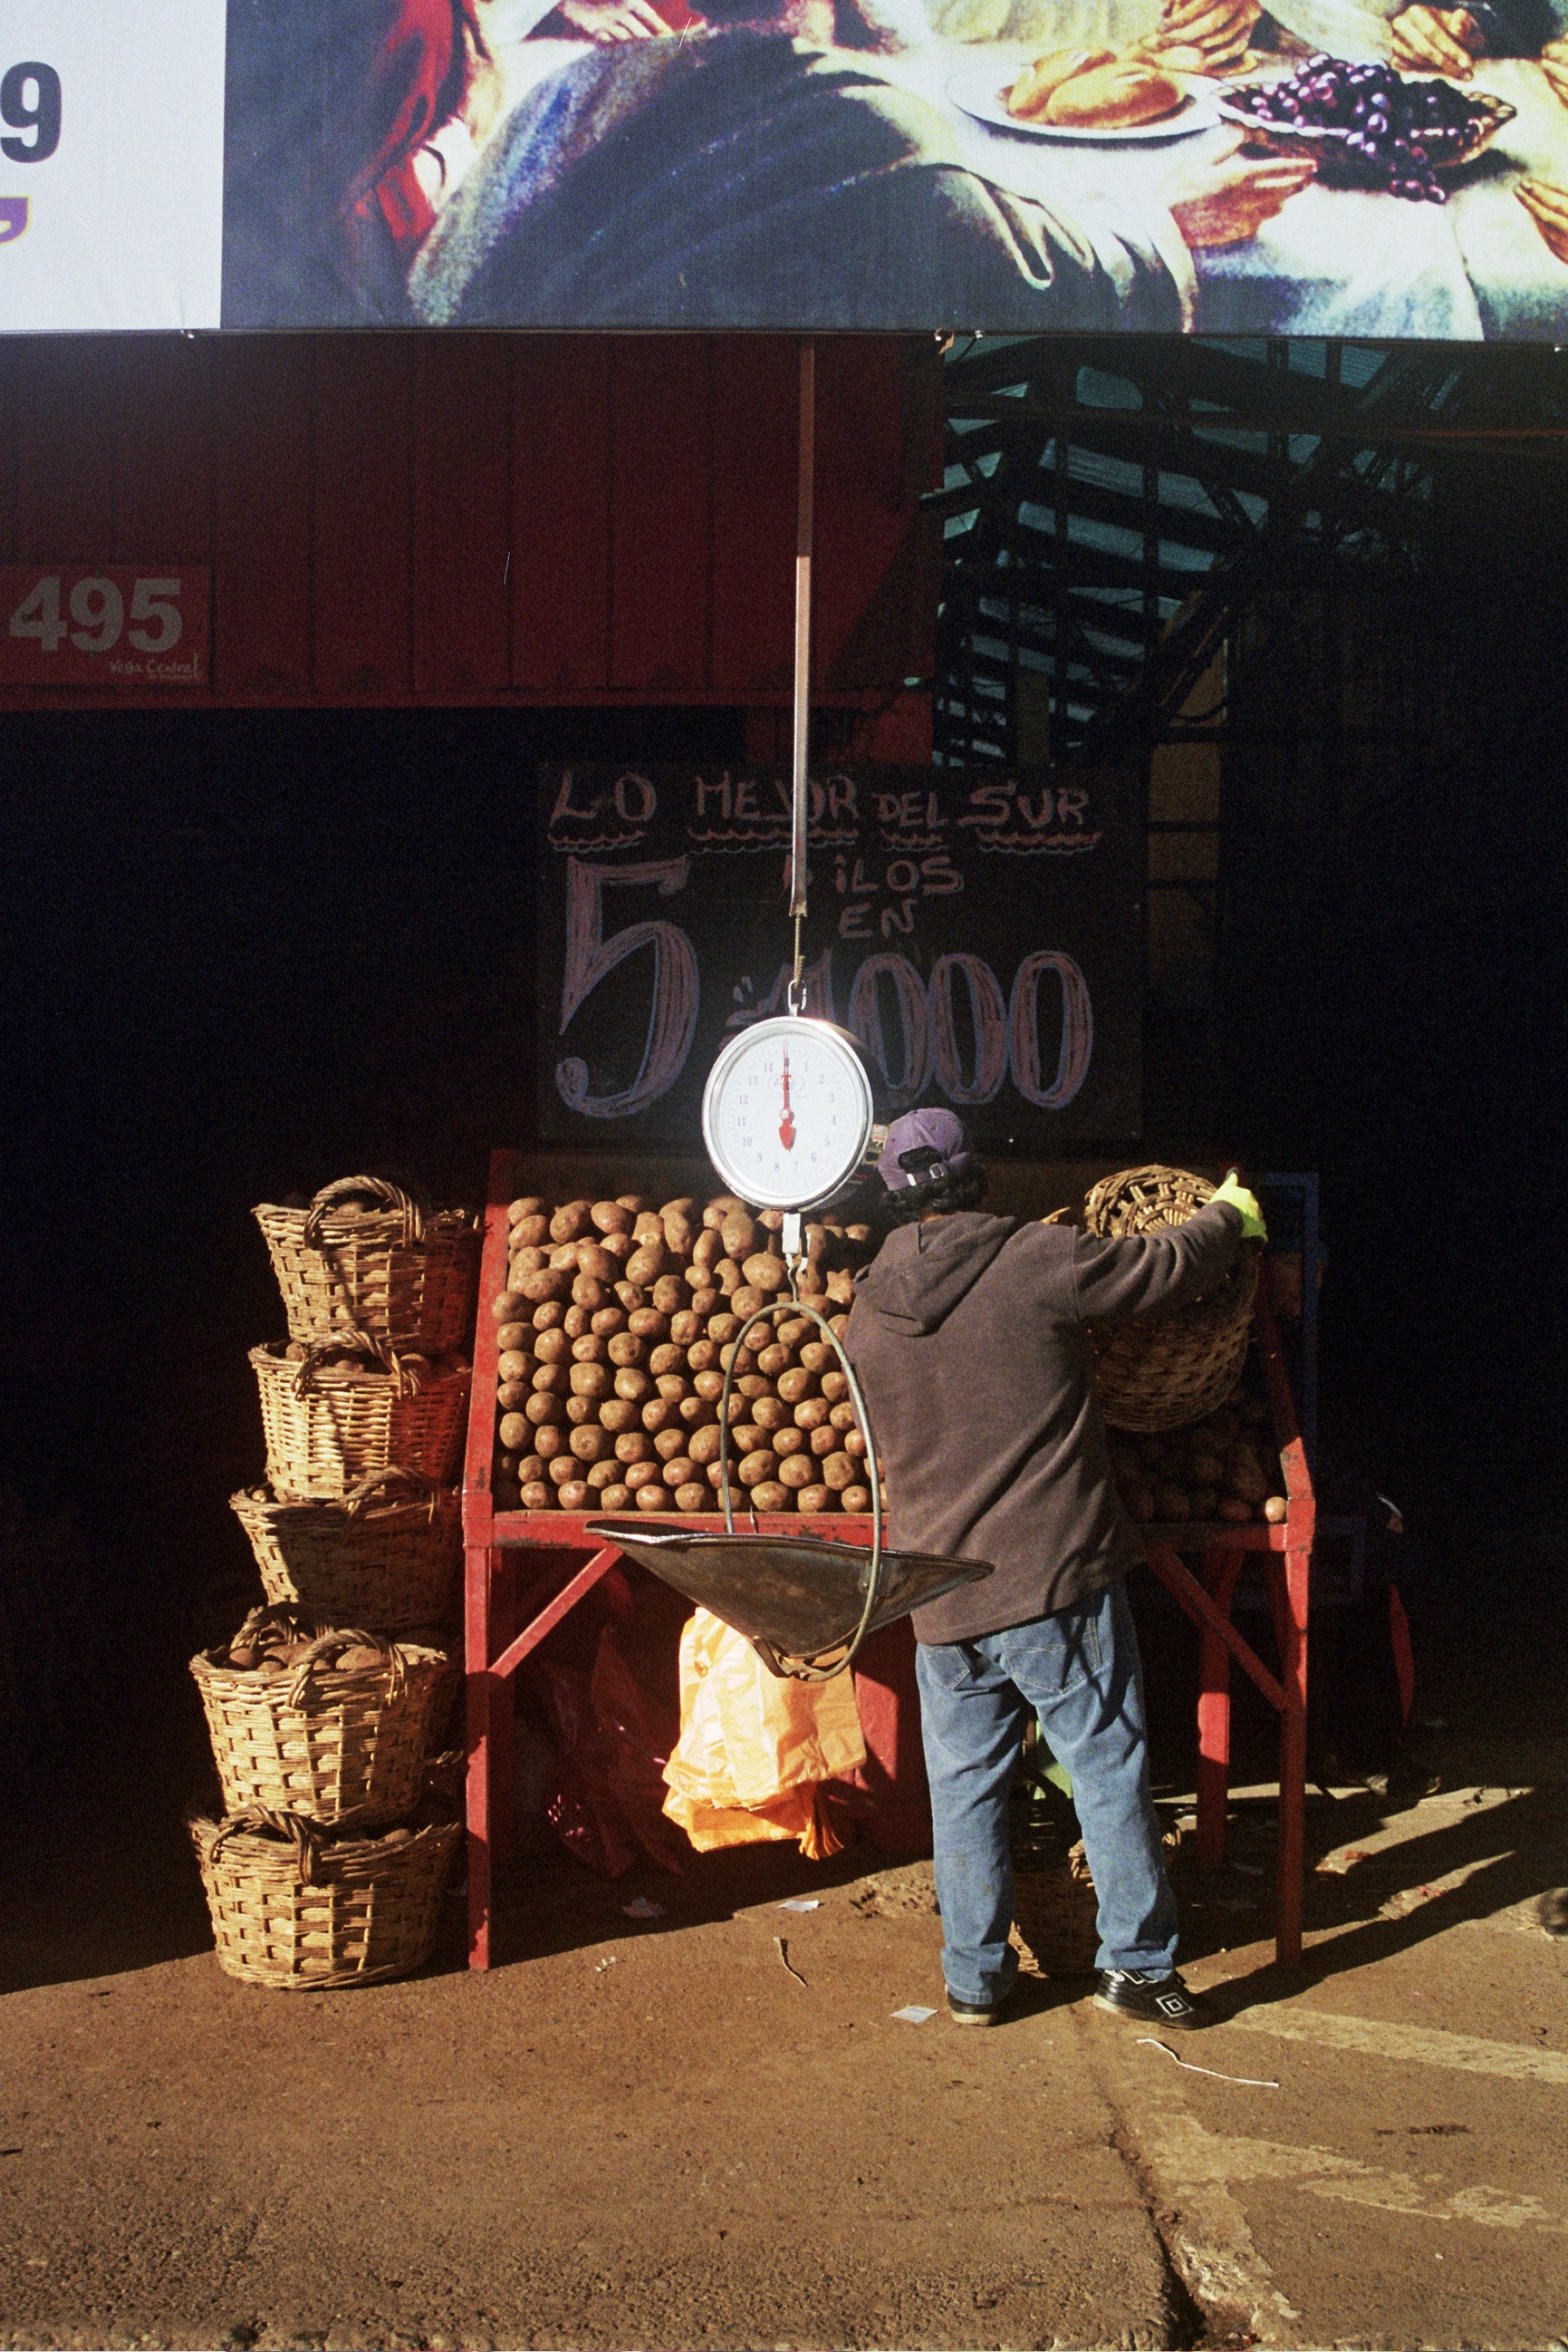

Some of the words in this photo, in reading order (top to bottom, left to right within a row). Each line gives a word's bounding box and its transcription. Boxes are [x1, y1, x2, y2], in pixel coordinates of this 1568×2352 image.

[9, 575, 183, 653] 495
[550, 769, 656, 825] LO
[873, 790, 948, 829] DEL
[956, 781, 1090, 828] SUR
[839, 899, 917, 939] EN
[554, 855, 700, 1120] 5
[764, 1062, 773, 1073] 14
[749, 1076, 758, 1085] 13
[818, 1074, 825, 1084] 2
[739, 1094, 749, 1105] 12
[828, 1093, 835, 1103] 3
[737, 1116, 746, 1126] 11
[830, 1115, 837, 1125] 4
[742, 1137, 752, 1147] 10
[825, 1137, 830, 1147] 5
[757, 1152, 763, 1163] 9
[811, 1152, 817, 1163] 6
[774, 1162, 780, 1171] 8
[793, 1162, 799, 1171] 7
